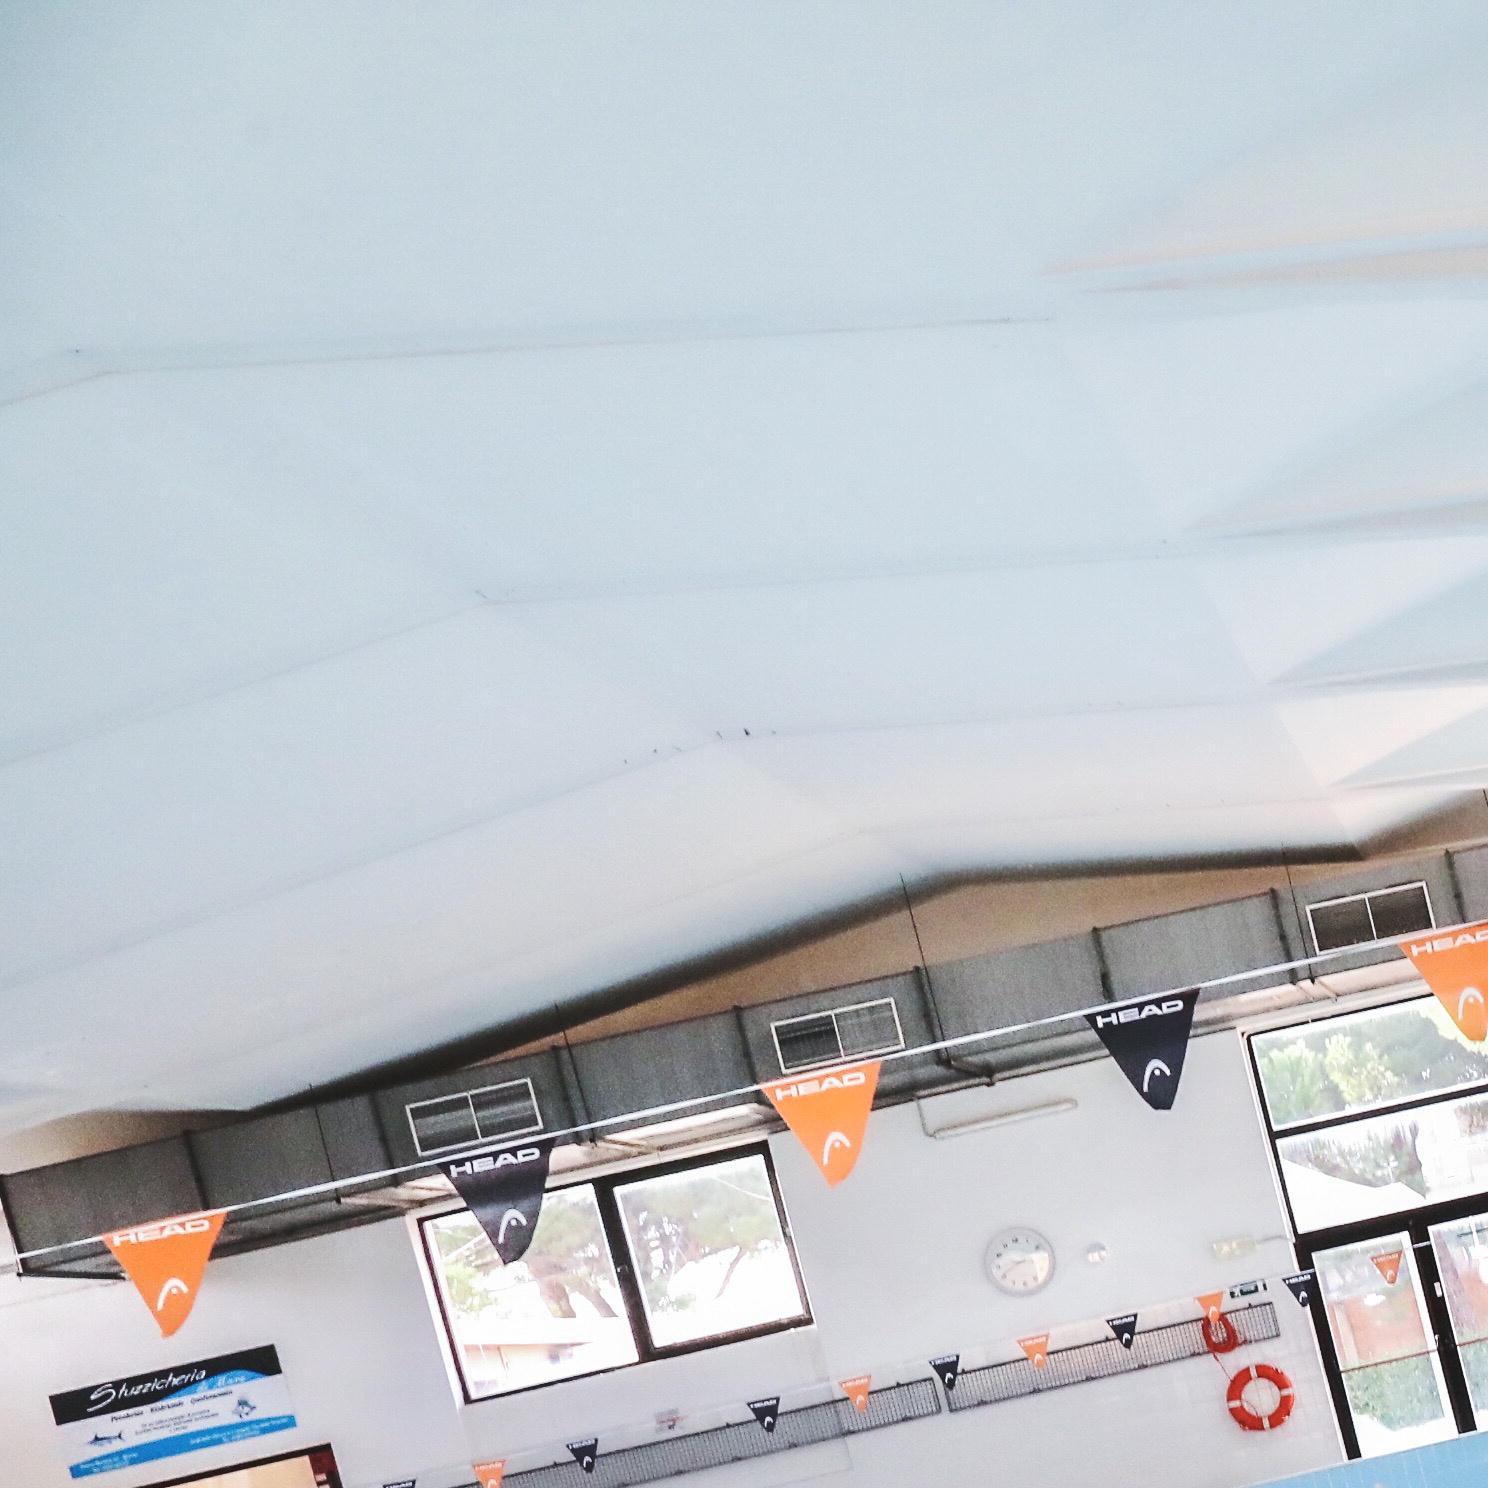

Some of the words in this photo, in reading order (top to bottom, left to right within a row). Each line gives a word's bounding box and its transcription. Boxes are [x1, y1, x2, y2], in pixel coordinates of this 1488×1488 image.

[1095, 998, 1186, 1029] HEAD
[774, 1070, 867, 1103] HEAD
[449, 1146, 541, 1178] HEAD
[112, 1219, 210, 1247] HEAD
